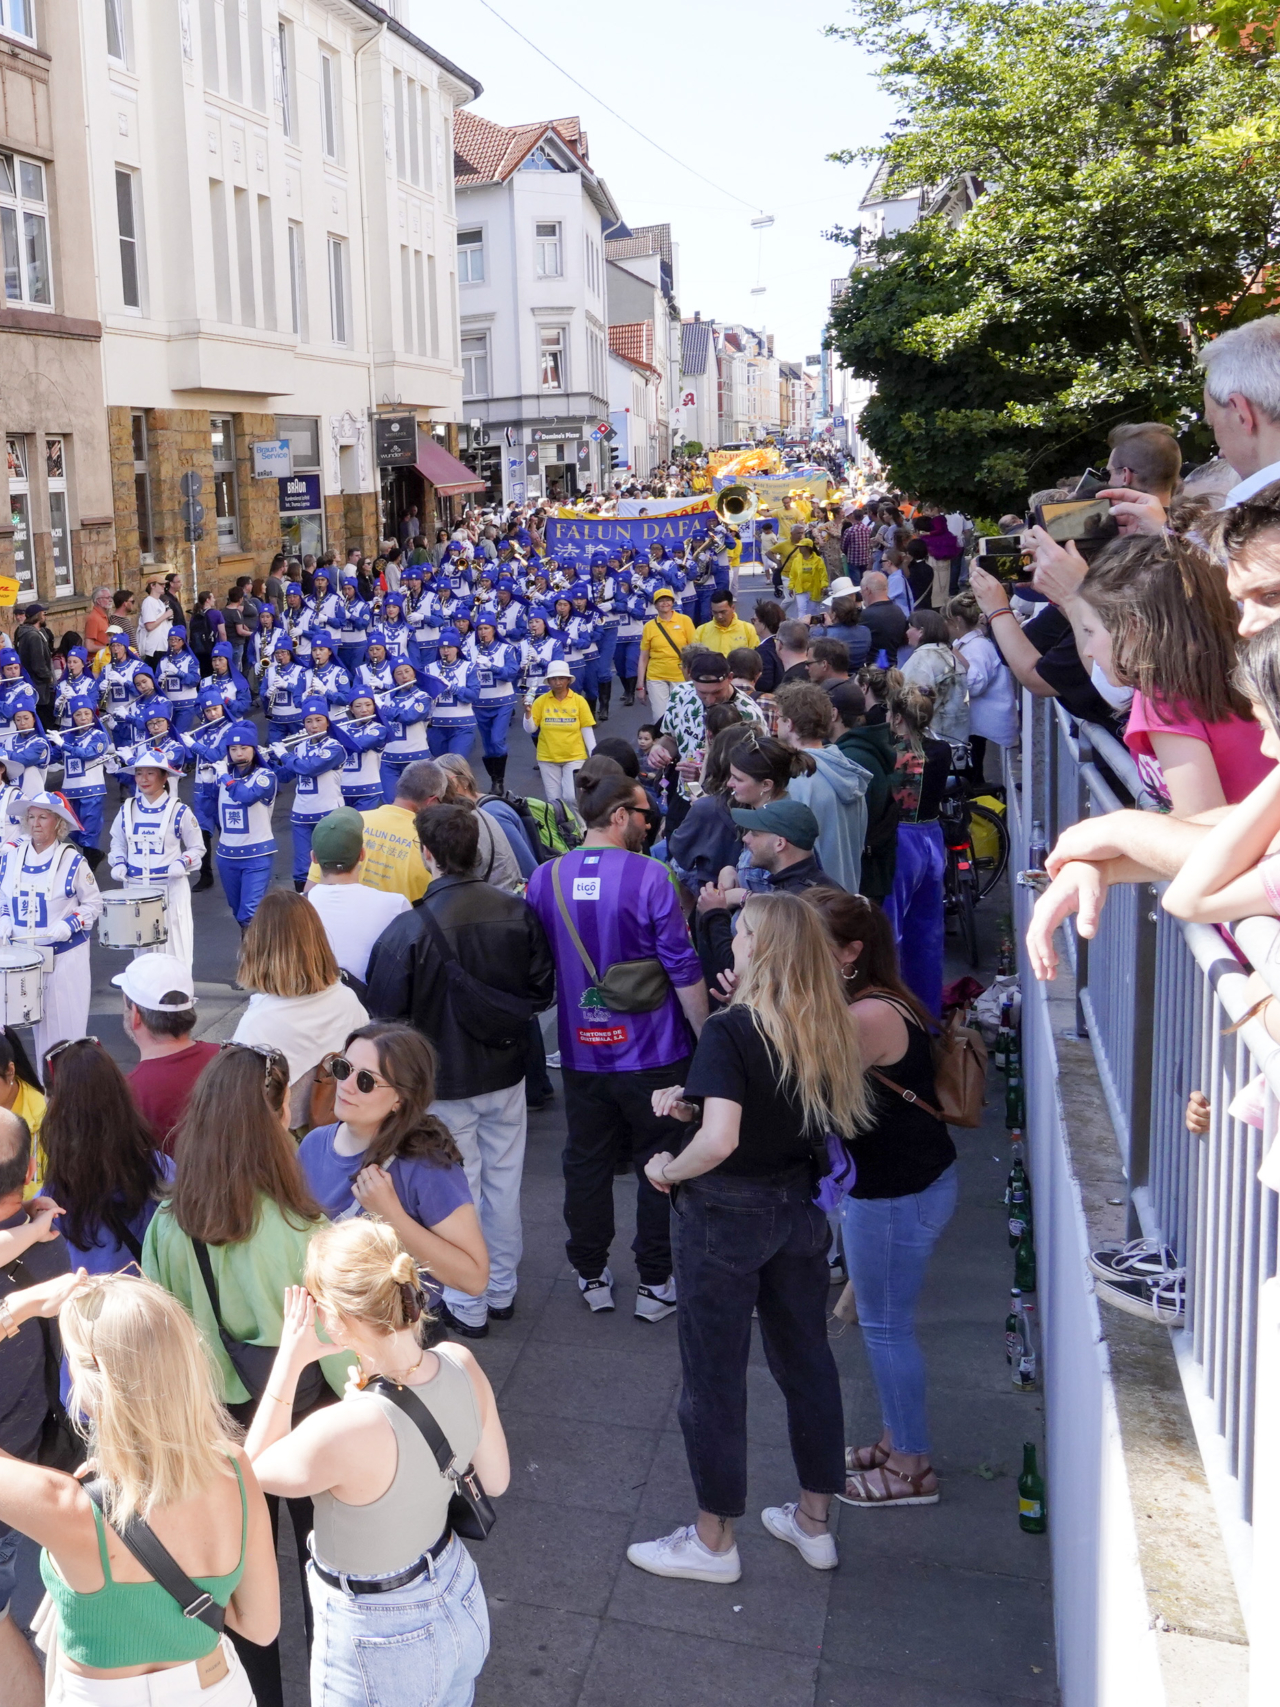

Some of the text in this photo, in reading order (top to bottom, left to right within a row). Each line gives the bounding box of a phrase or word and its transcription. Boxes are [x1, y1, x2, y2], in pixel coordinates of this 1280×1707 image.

[836, 417, 843, 426] P
[542, 432, 564, 440] Domino's
[256, 446, 276, 454] Braun
[262, 452, 288, 460] Service
[287, 478, 306, 494] BRAUN
[556, 518, 701, 540] FALUN DAFA
[362, 826, 412, 848] ALUN DAFA
[366, 839, 409, 860] 輪大法好
